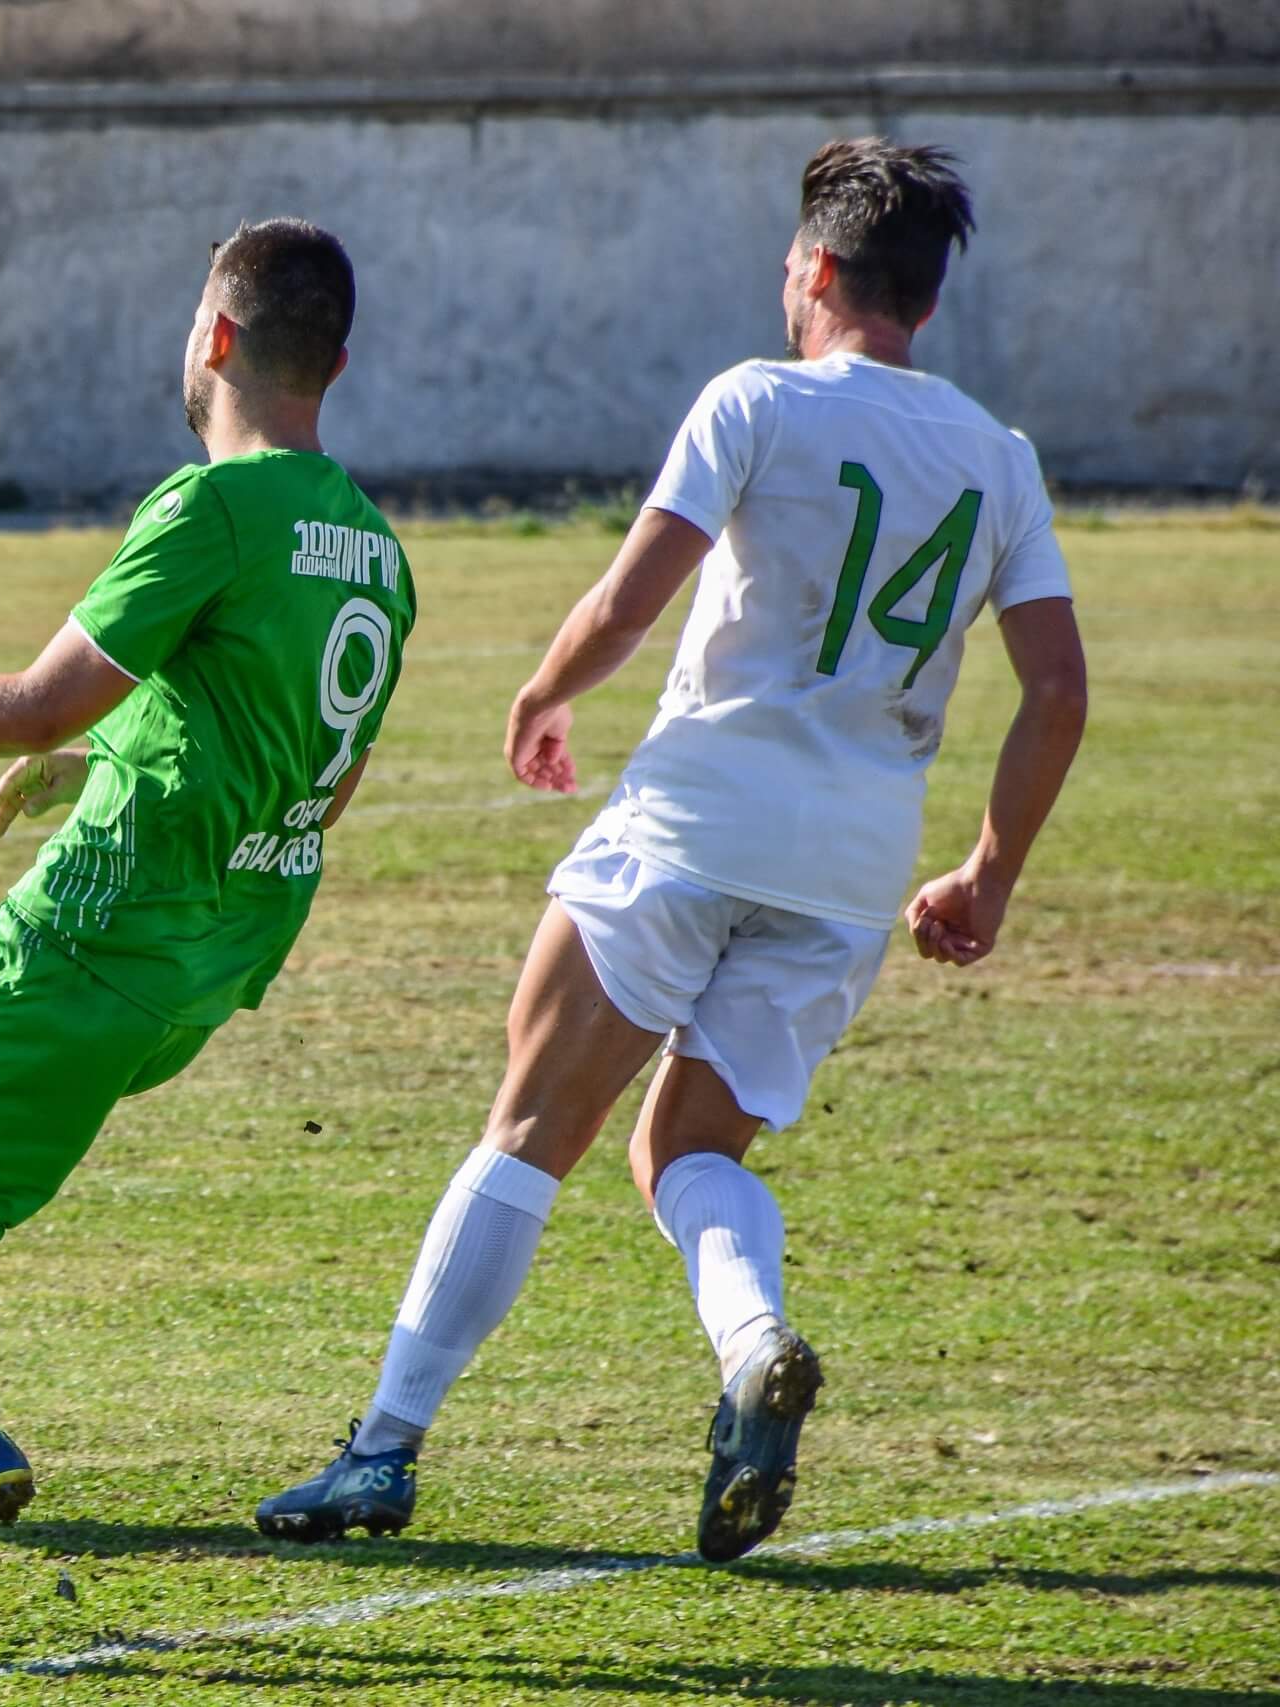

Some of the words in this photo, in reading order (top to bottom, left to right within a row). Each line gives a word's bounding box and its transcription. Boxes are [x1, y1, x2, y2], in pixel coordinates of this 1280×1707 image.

[334, 525, 400, 594] ПИРИН
[816, 461, 984, 690] 14
[314, 597, 392, 788] 9
